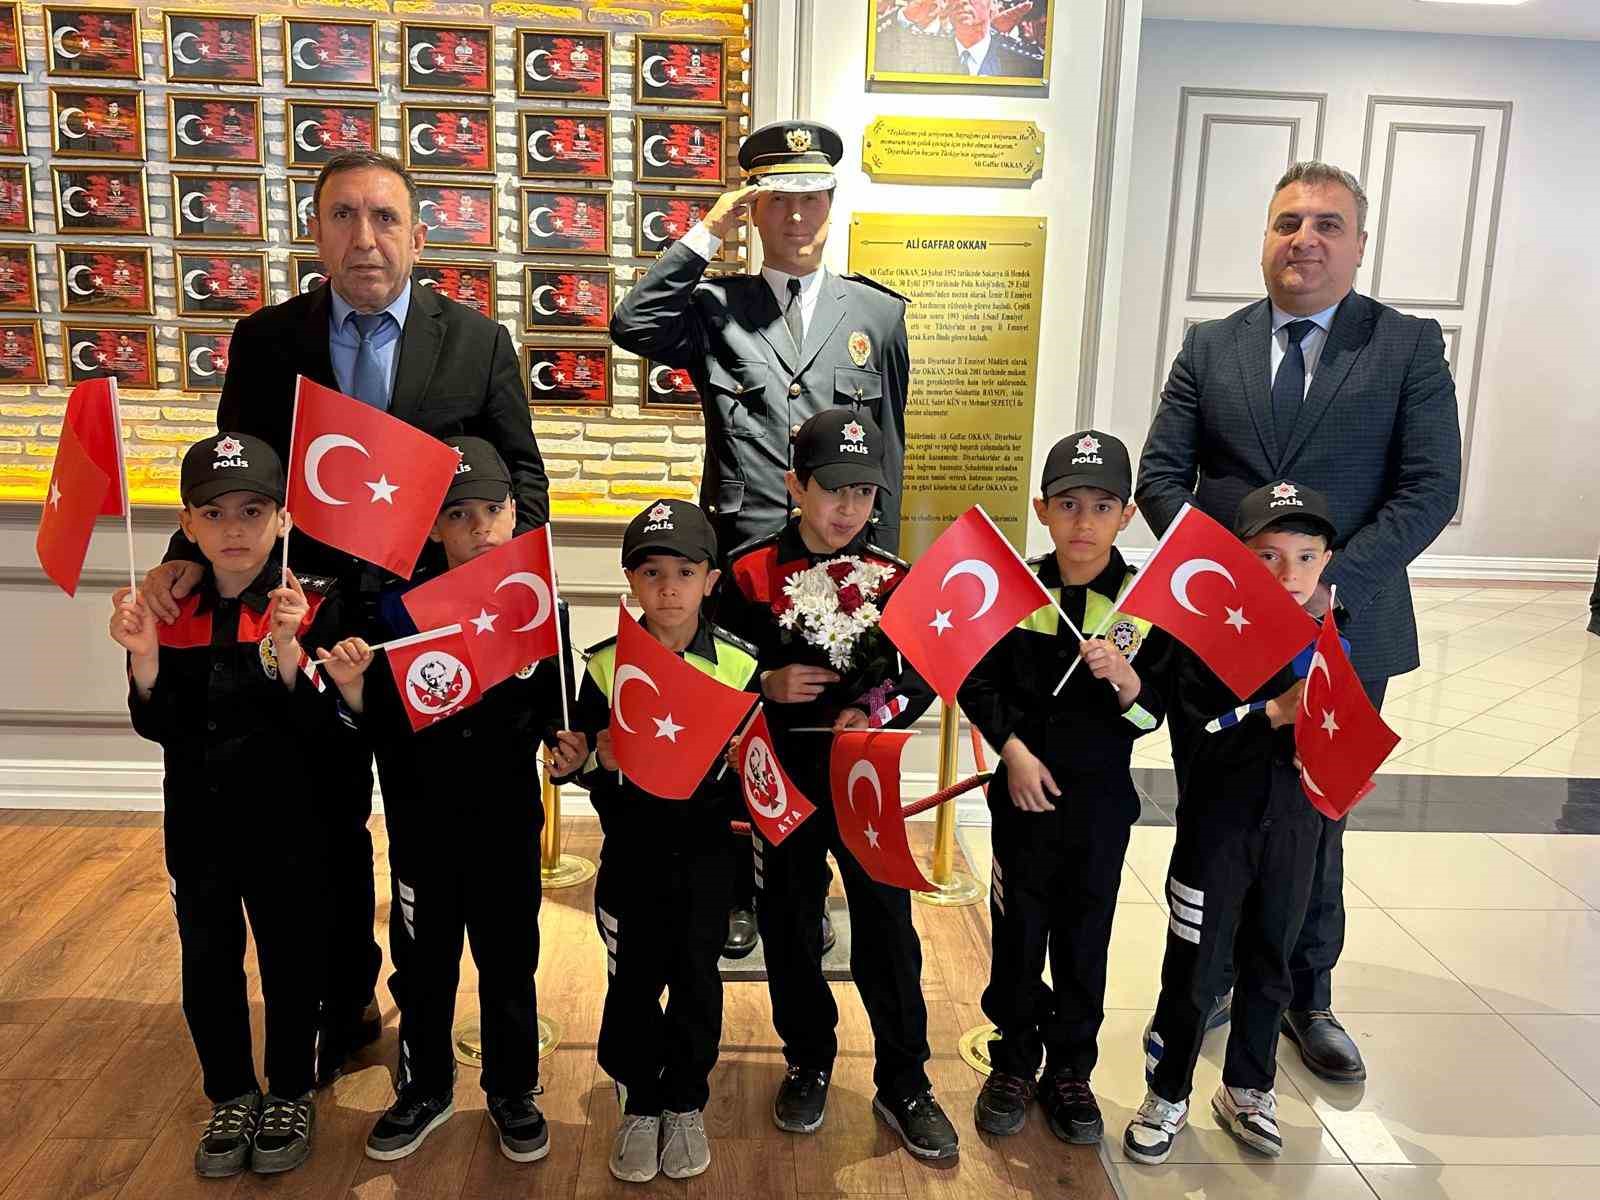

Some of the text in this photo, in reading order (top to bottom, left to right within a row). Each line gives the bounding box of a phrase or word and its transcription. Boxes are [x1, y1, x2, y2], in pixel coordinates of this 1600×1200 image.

[906, 237, 986, 250] ALİ GAFFAR OKKAN
[840, 443, 868, 455] POLİS
[777, 810, 802, 834] ATA
